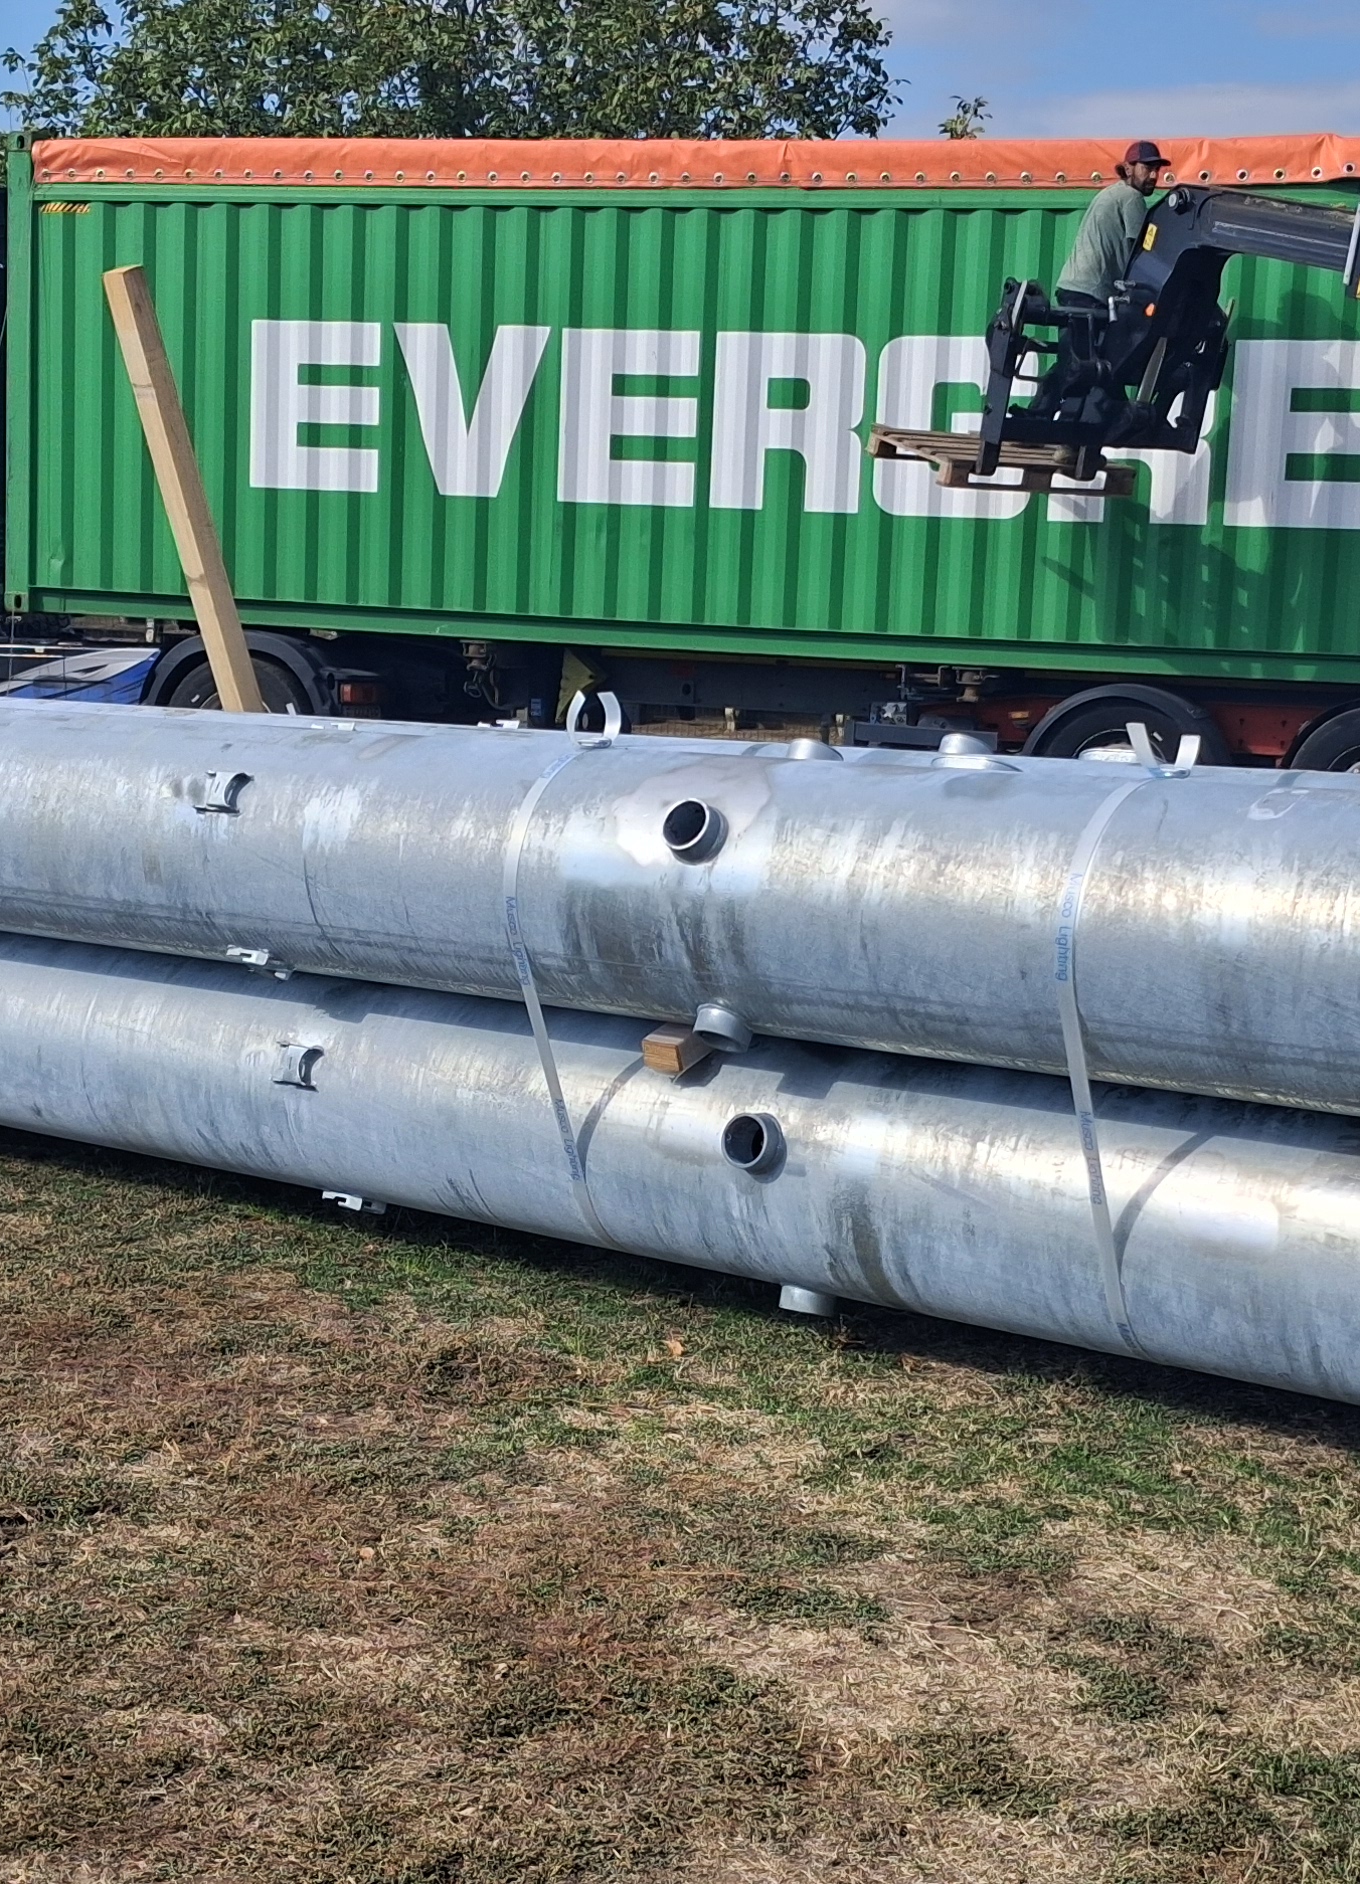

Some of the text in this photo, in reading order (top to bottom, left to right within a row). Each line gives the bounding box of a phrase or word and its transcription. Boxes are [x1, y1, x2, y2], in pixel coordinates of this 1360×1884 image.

[505, 896, 531, 986] Musco Lighting
[1055, 873, 1084, 981] Musco Lighting
[555, 1098, 569, 1133] Musco
